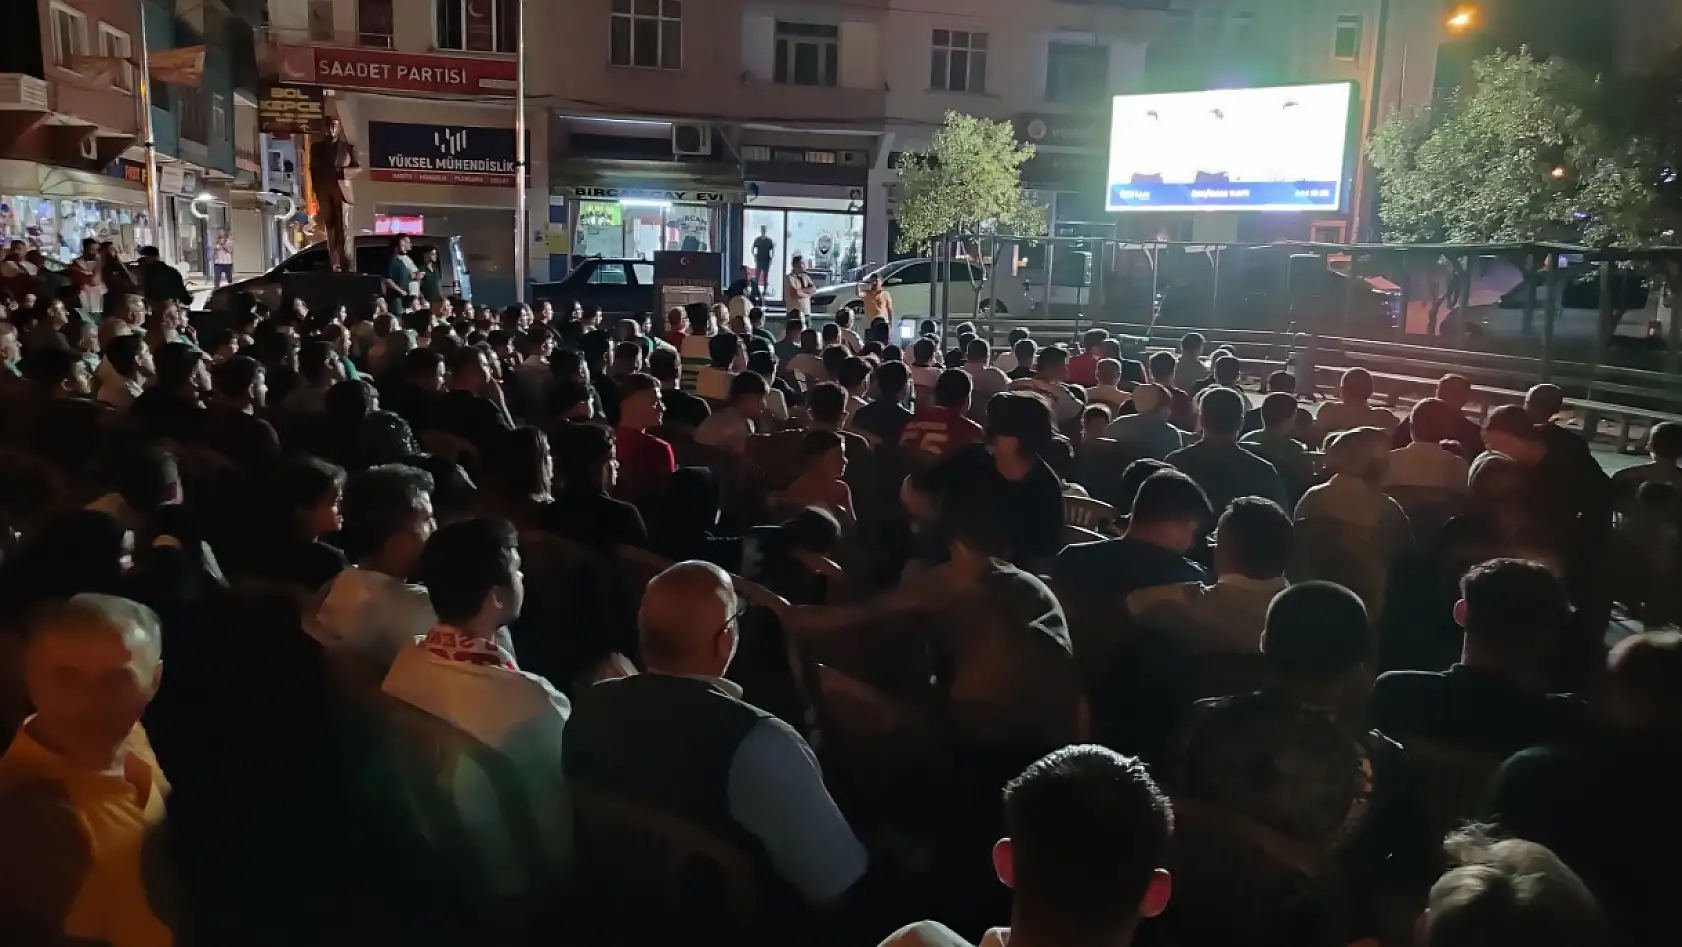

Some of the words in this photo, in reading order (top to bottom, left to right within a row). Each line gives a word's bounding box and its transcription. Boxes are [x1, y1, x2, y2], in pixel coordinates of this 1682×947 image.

[319, 60, 391, 79] SAADET
[388, 153, 433, 168] YÜKSEL
[435, 156, 514, 172] MÜHENDİSLİK
